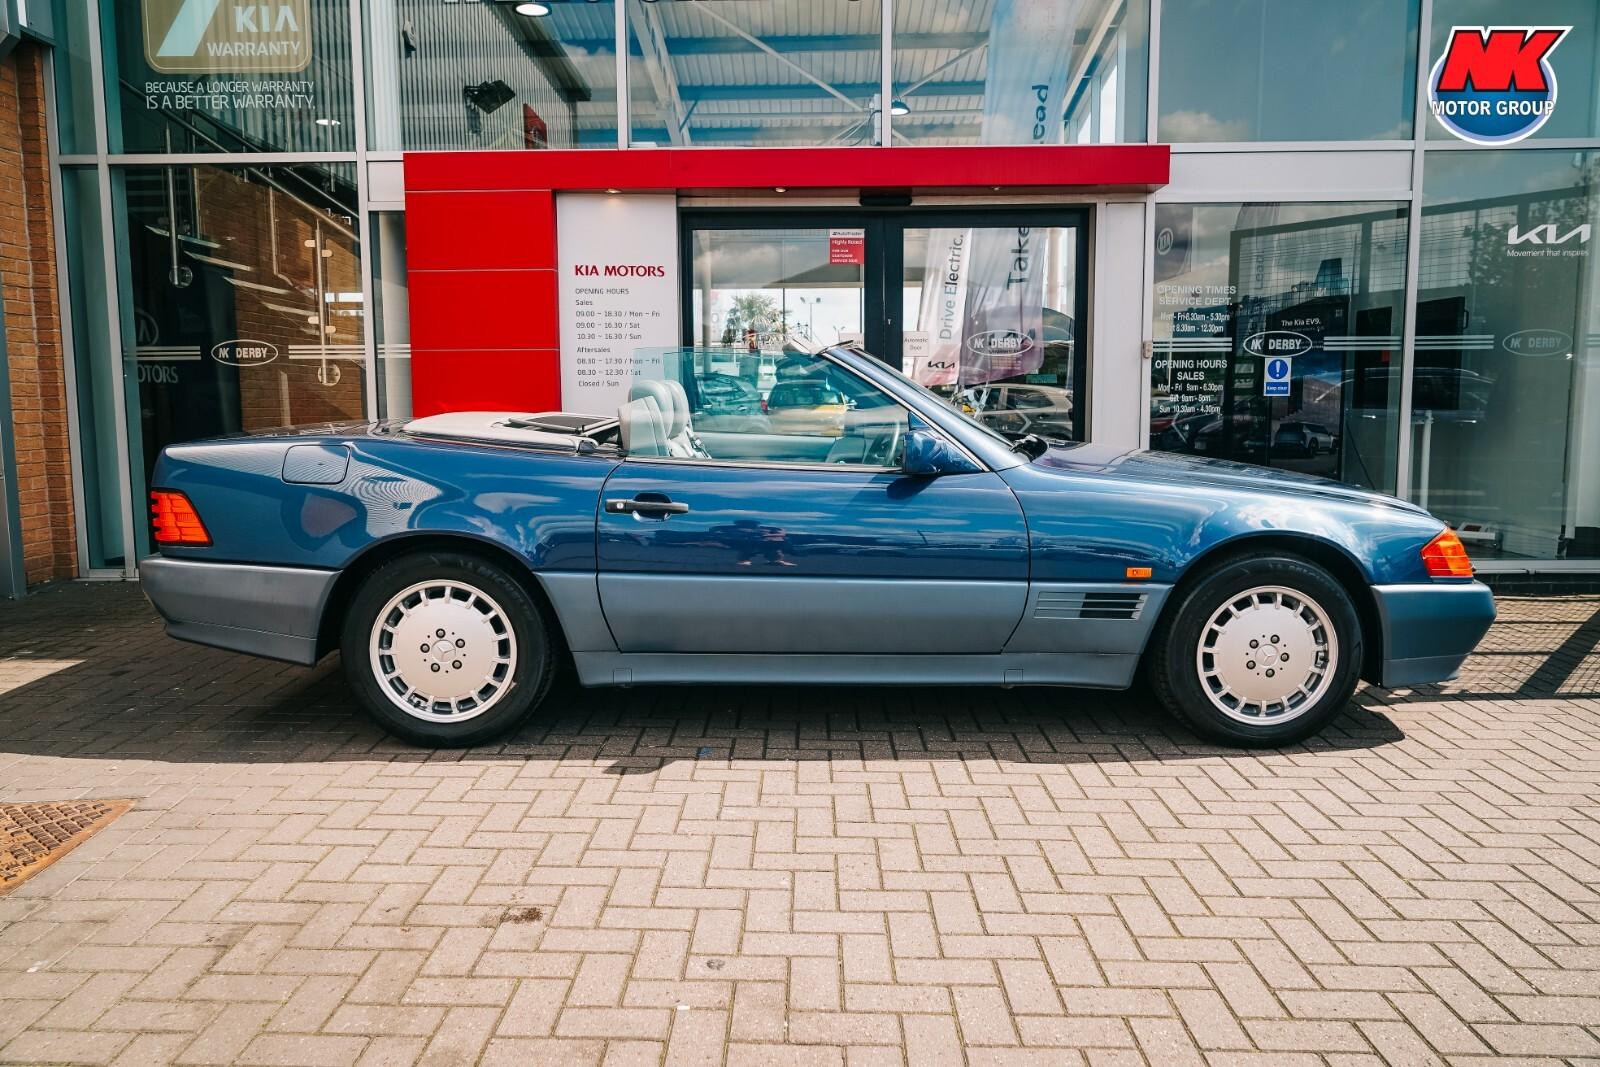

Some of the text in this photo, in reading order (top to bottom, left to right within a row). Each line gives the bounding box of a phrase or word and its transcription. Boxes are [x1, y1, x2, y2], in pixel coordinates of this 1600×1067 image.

[233, 6, 298, 33] KIA
[207, 41, 300, 57] WARRANTY
[145, 80, 314, 94] BECAUSE A LONGER WARRANTY
[146, 94, 316, 110] IS A BETTER WARRANTY.
[1032, 84, 1048, 143] ead
[1507, 224, 1592, 245] KIA
[1006, 226, 1030, 291] Take
[1507, 249, 1545, 257] Movement
[1562, 249, 1589, 258] inspires
[574, 264, 665, 278] KIA MOTORS
[939, 234, 964, 340] Drive Electric.
[1157, 285, 1237, 294] OPENING TIMES
[1159, 297, 1233, 306] SERVICE DEPT.
[1201, 324, 1224, 333] 12.30pm
[991, 337, 1023, 349] DERBY
[1268, 338, 1302, 350] DERBY
[1528, 337, 1562, 348] DERBY
[236, 347, 268, 358] DERBY
[1155, 359, 1228, 369] OPENING HOURS
[137, 364, 179, 384] OTORS
[1176, 371, 1205, 381] SALES
[1174, 383, 1183, 391] Fri
[1186, 383, 1198, 391] 9am
[1181, 394, 1194, 402] 9am
[1198, 394, 1211, 403] 5pm
[1159, 405, 1170, 413] Sun
[1173, 404, 1196, 413] 10.30am
